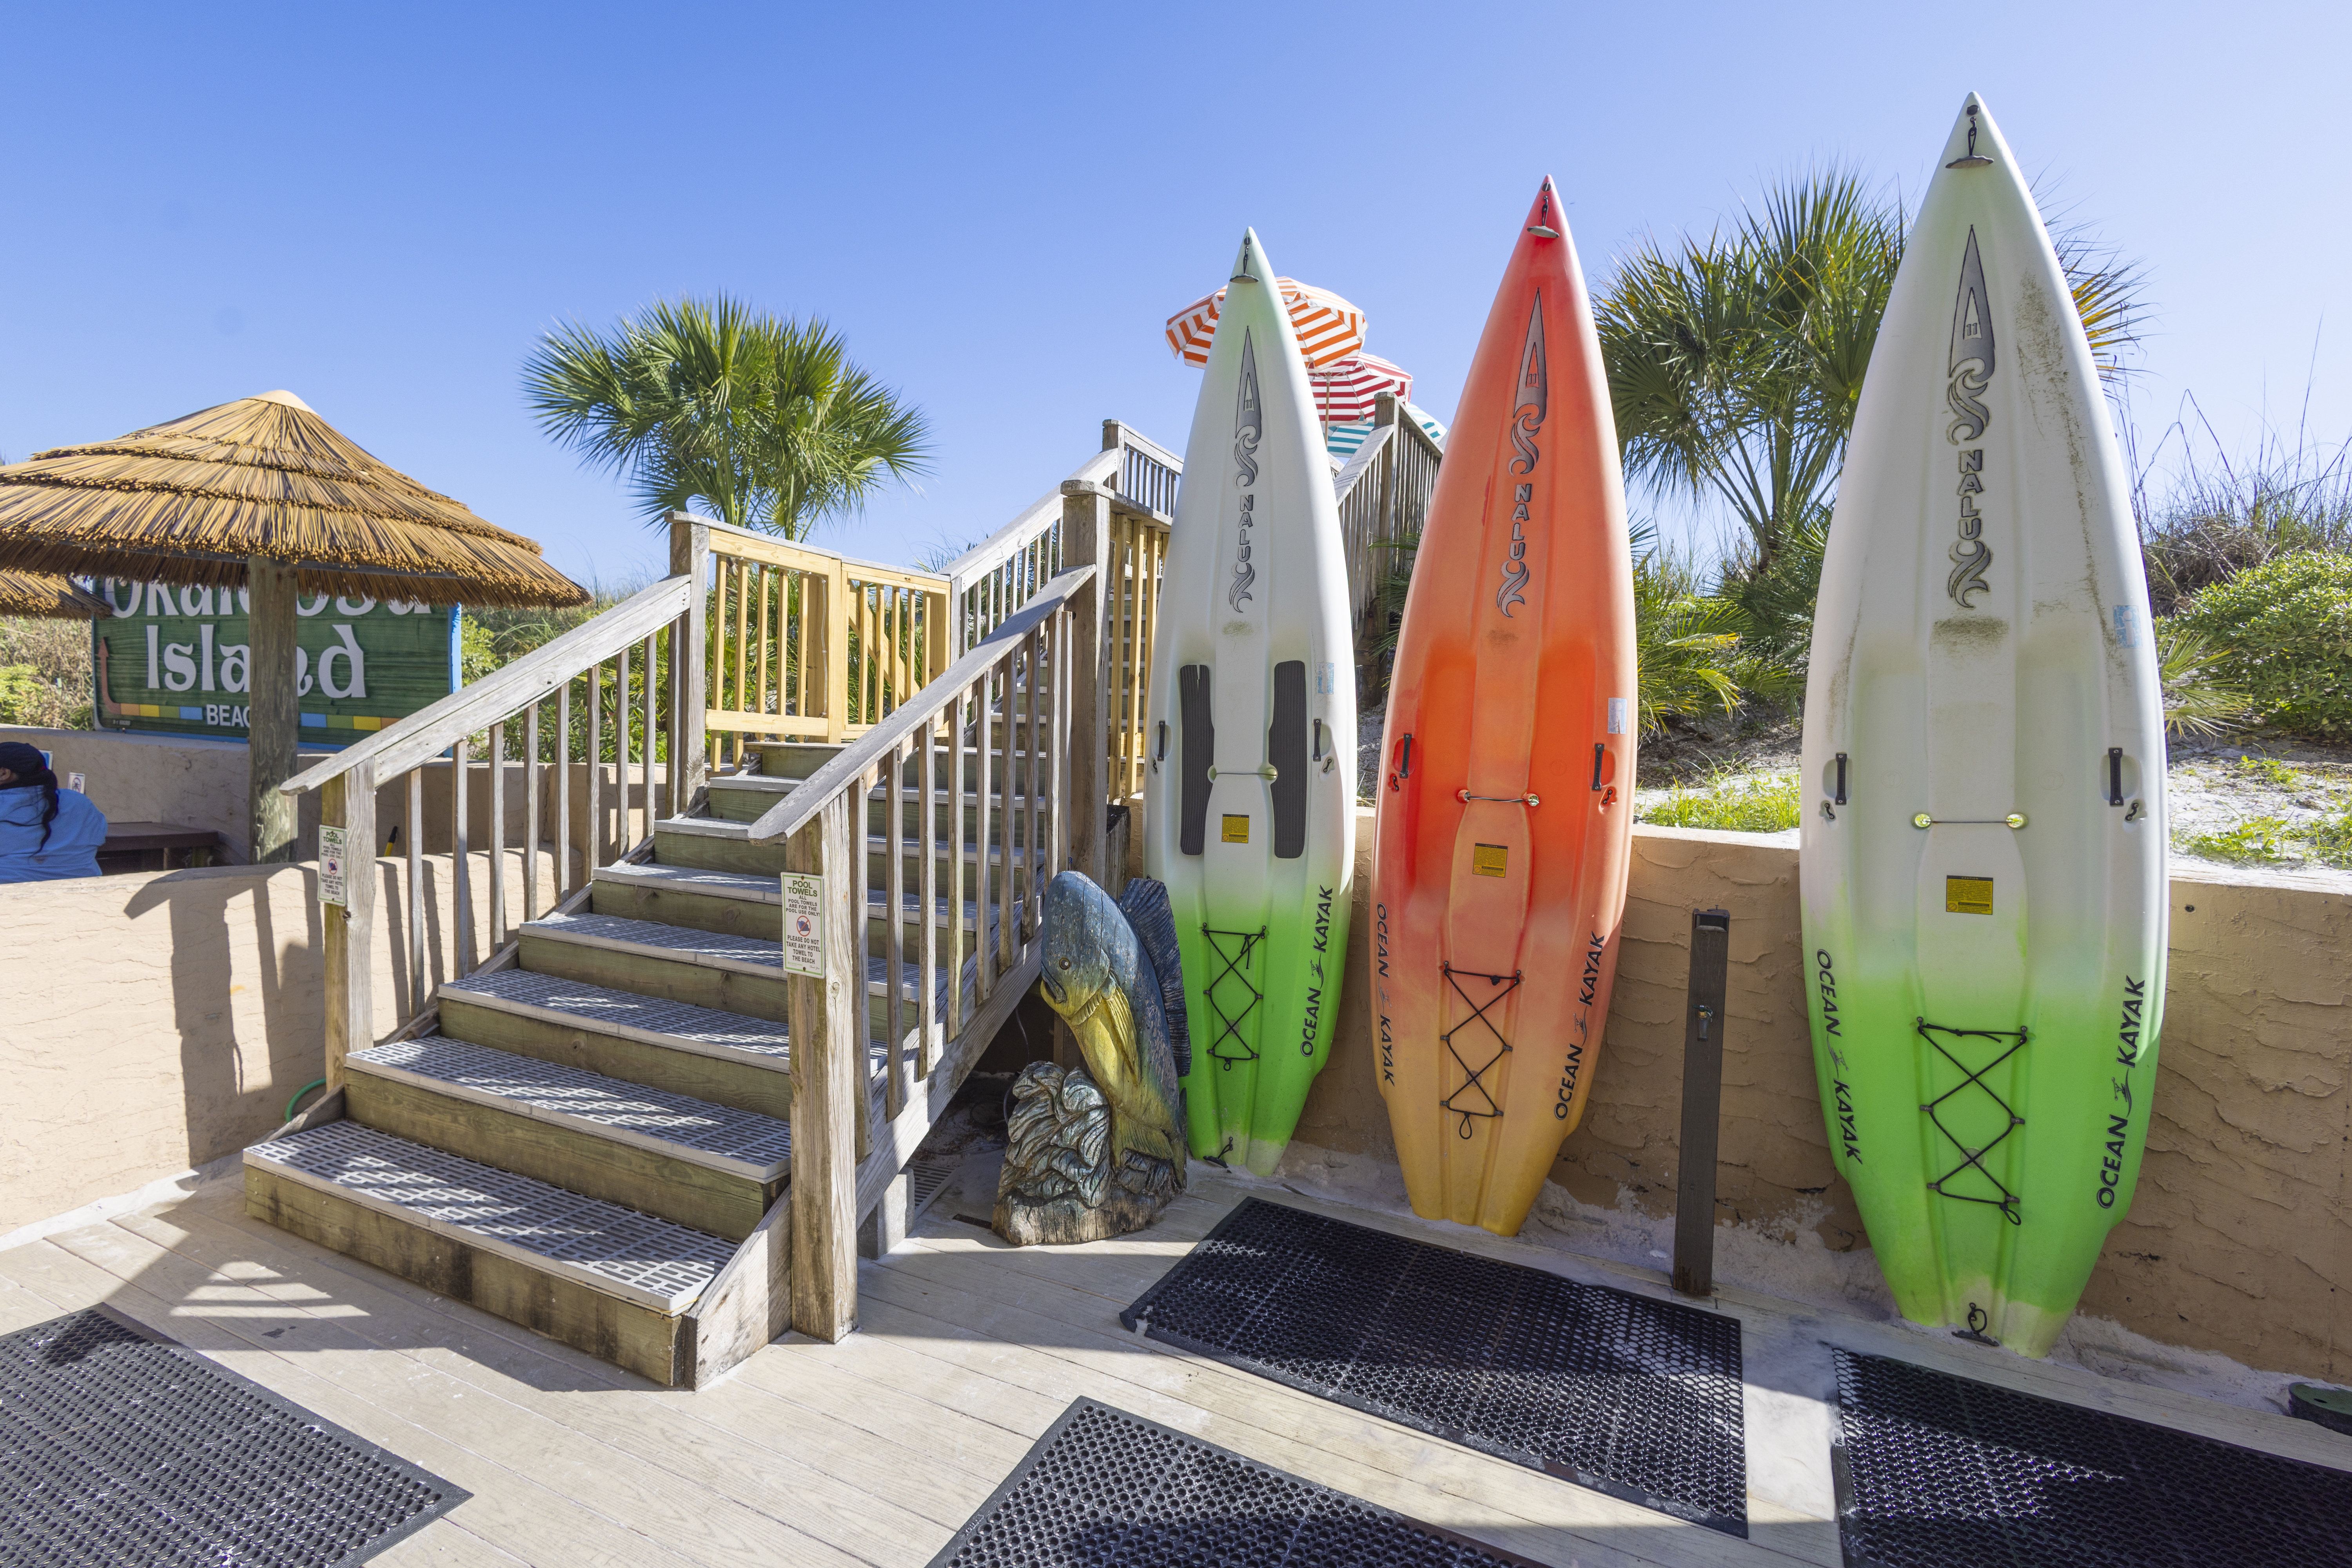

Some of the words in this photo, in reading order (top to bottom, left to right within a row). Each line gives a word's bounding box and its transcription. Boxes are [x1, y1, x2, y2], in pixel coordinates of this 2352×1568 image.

[1238, 495, 1254, 563] NALU
[1509, 483, 1532, 561] NALU
[1958, 449, 1983, 540] NALU
[323, 836, 342, 844] TOWELS
[787, 887, 817, 897] TOWELS
[793, 880, 813, 889] POOL
[1300, 987, 1321, 1057] OCEAN
[1313, 885, 1333, 953] KAYAK
[1377, 902, 1389, 978] OCEAN
[1380, 1013, 1395, 1087] KAYAK
[1554, 1043, 1583, 1120] OCEAN
[1578, 931, 1605, 1007] KAYAK
[1817, 949, 1842, 1037] OCEAN
[1833, 1078, 1863, 1165] KAYAK
[2096, 1114, 2128, 1209] OCEAN
[2117, 975, 2145, 1068] KAYAK
